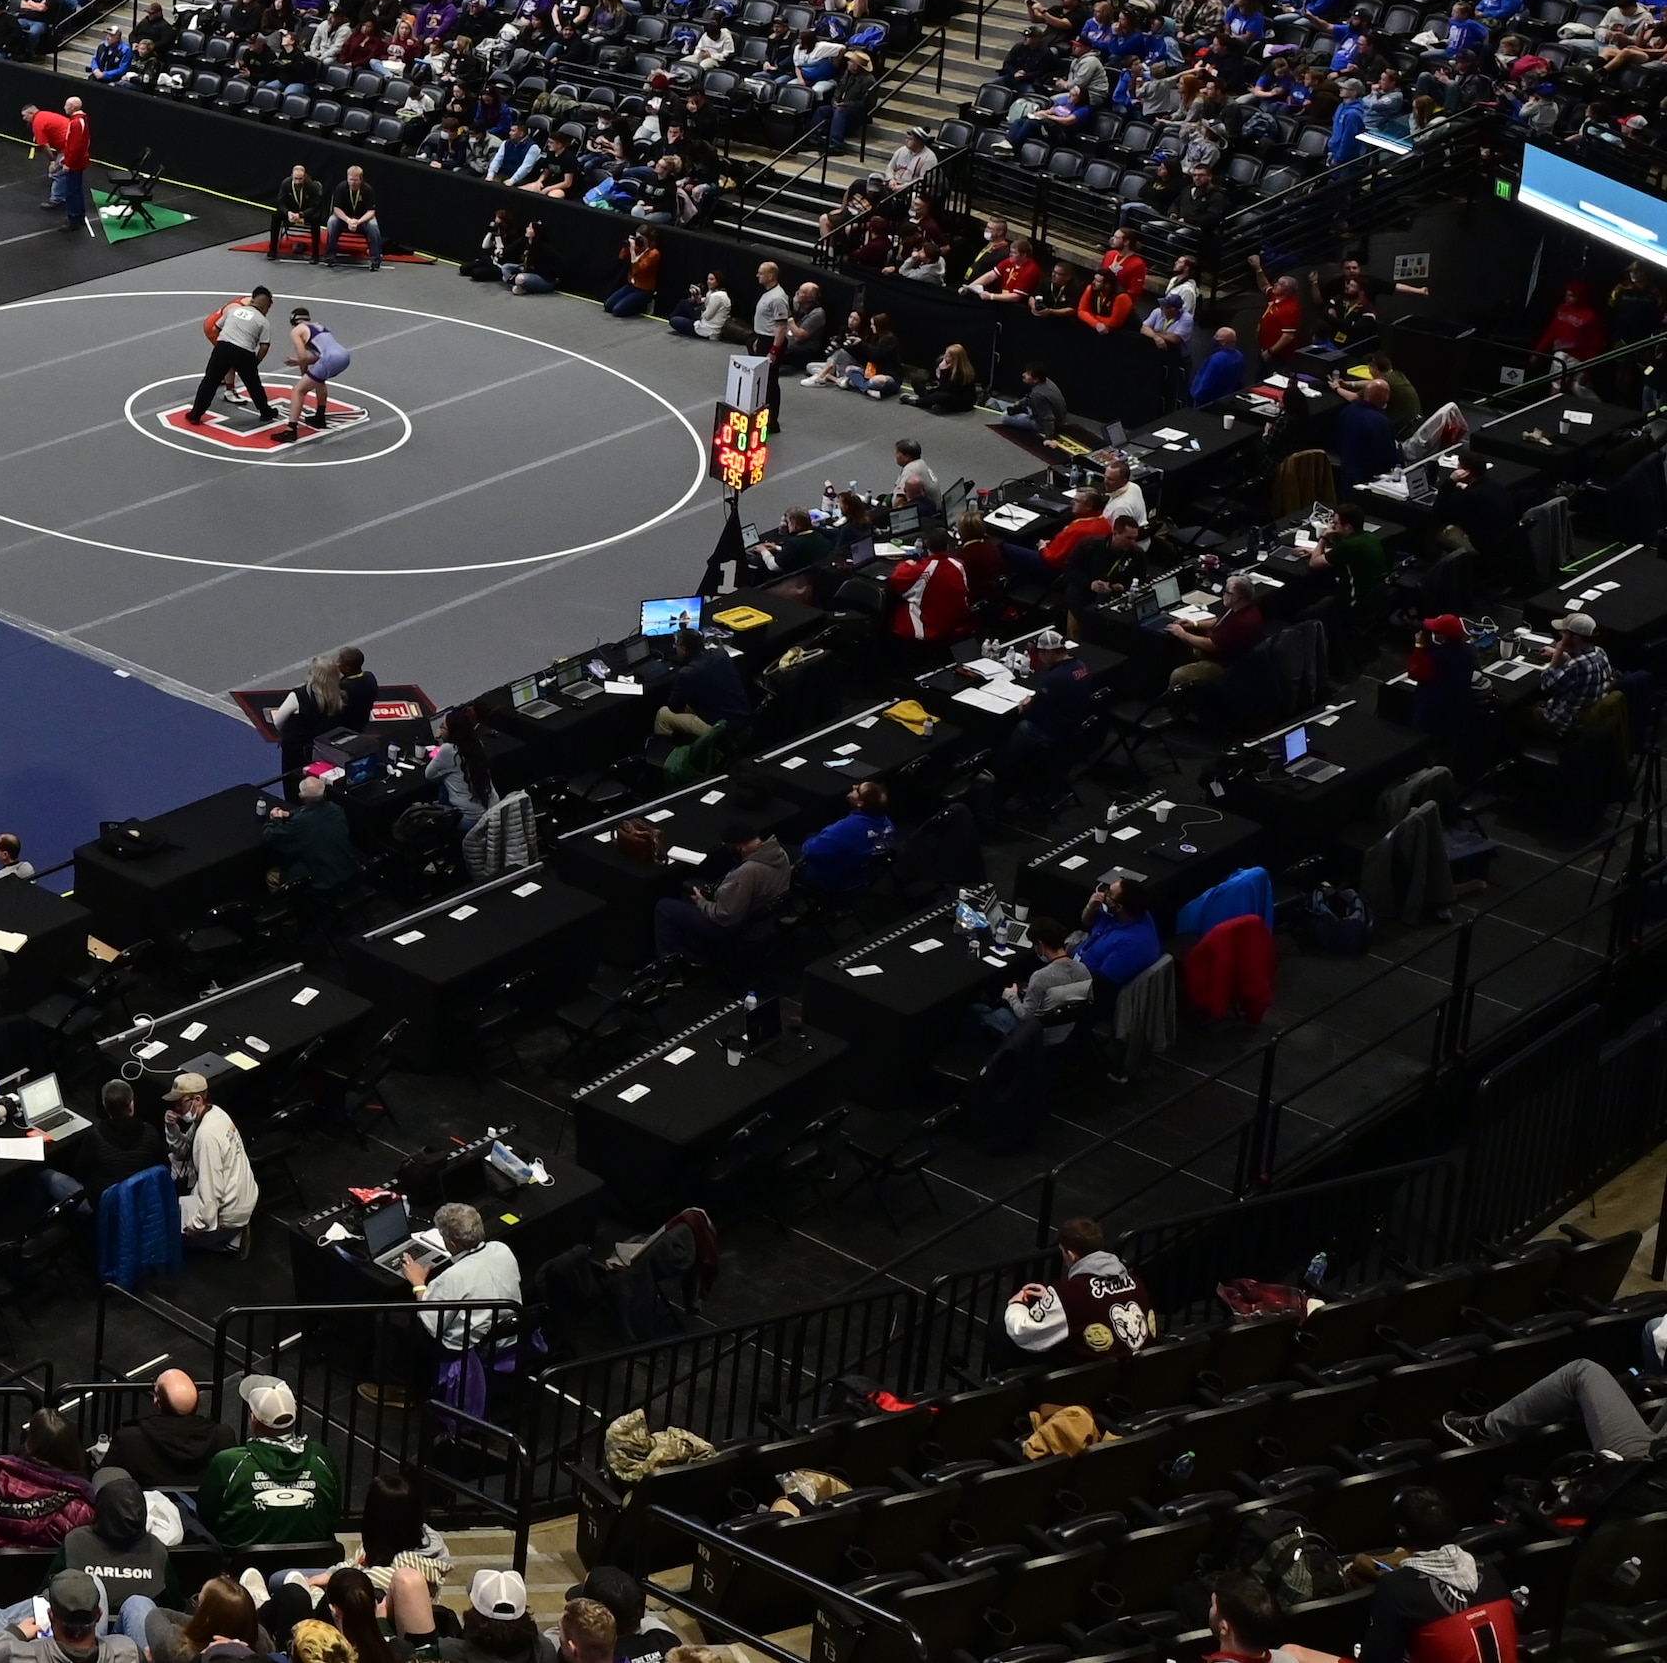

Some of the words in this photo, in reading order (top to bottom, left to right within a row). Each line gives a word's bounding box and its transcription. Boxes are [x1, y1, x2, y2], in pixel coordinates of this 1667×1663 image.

[729, 412, 747, 433] 158
[720, 448, 746, 474] 2:00
[723, 470, 743, 491] 195
[716, 559, 738, 595] 1
[588, 1521, 598, 1539] 11
[85, 1565, 152, 1580] CARLSON
[702, 1573, 715, 1595] 12
[823, 1641, 837, 1663] 13
